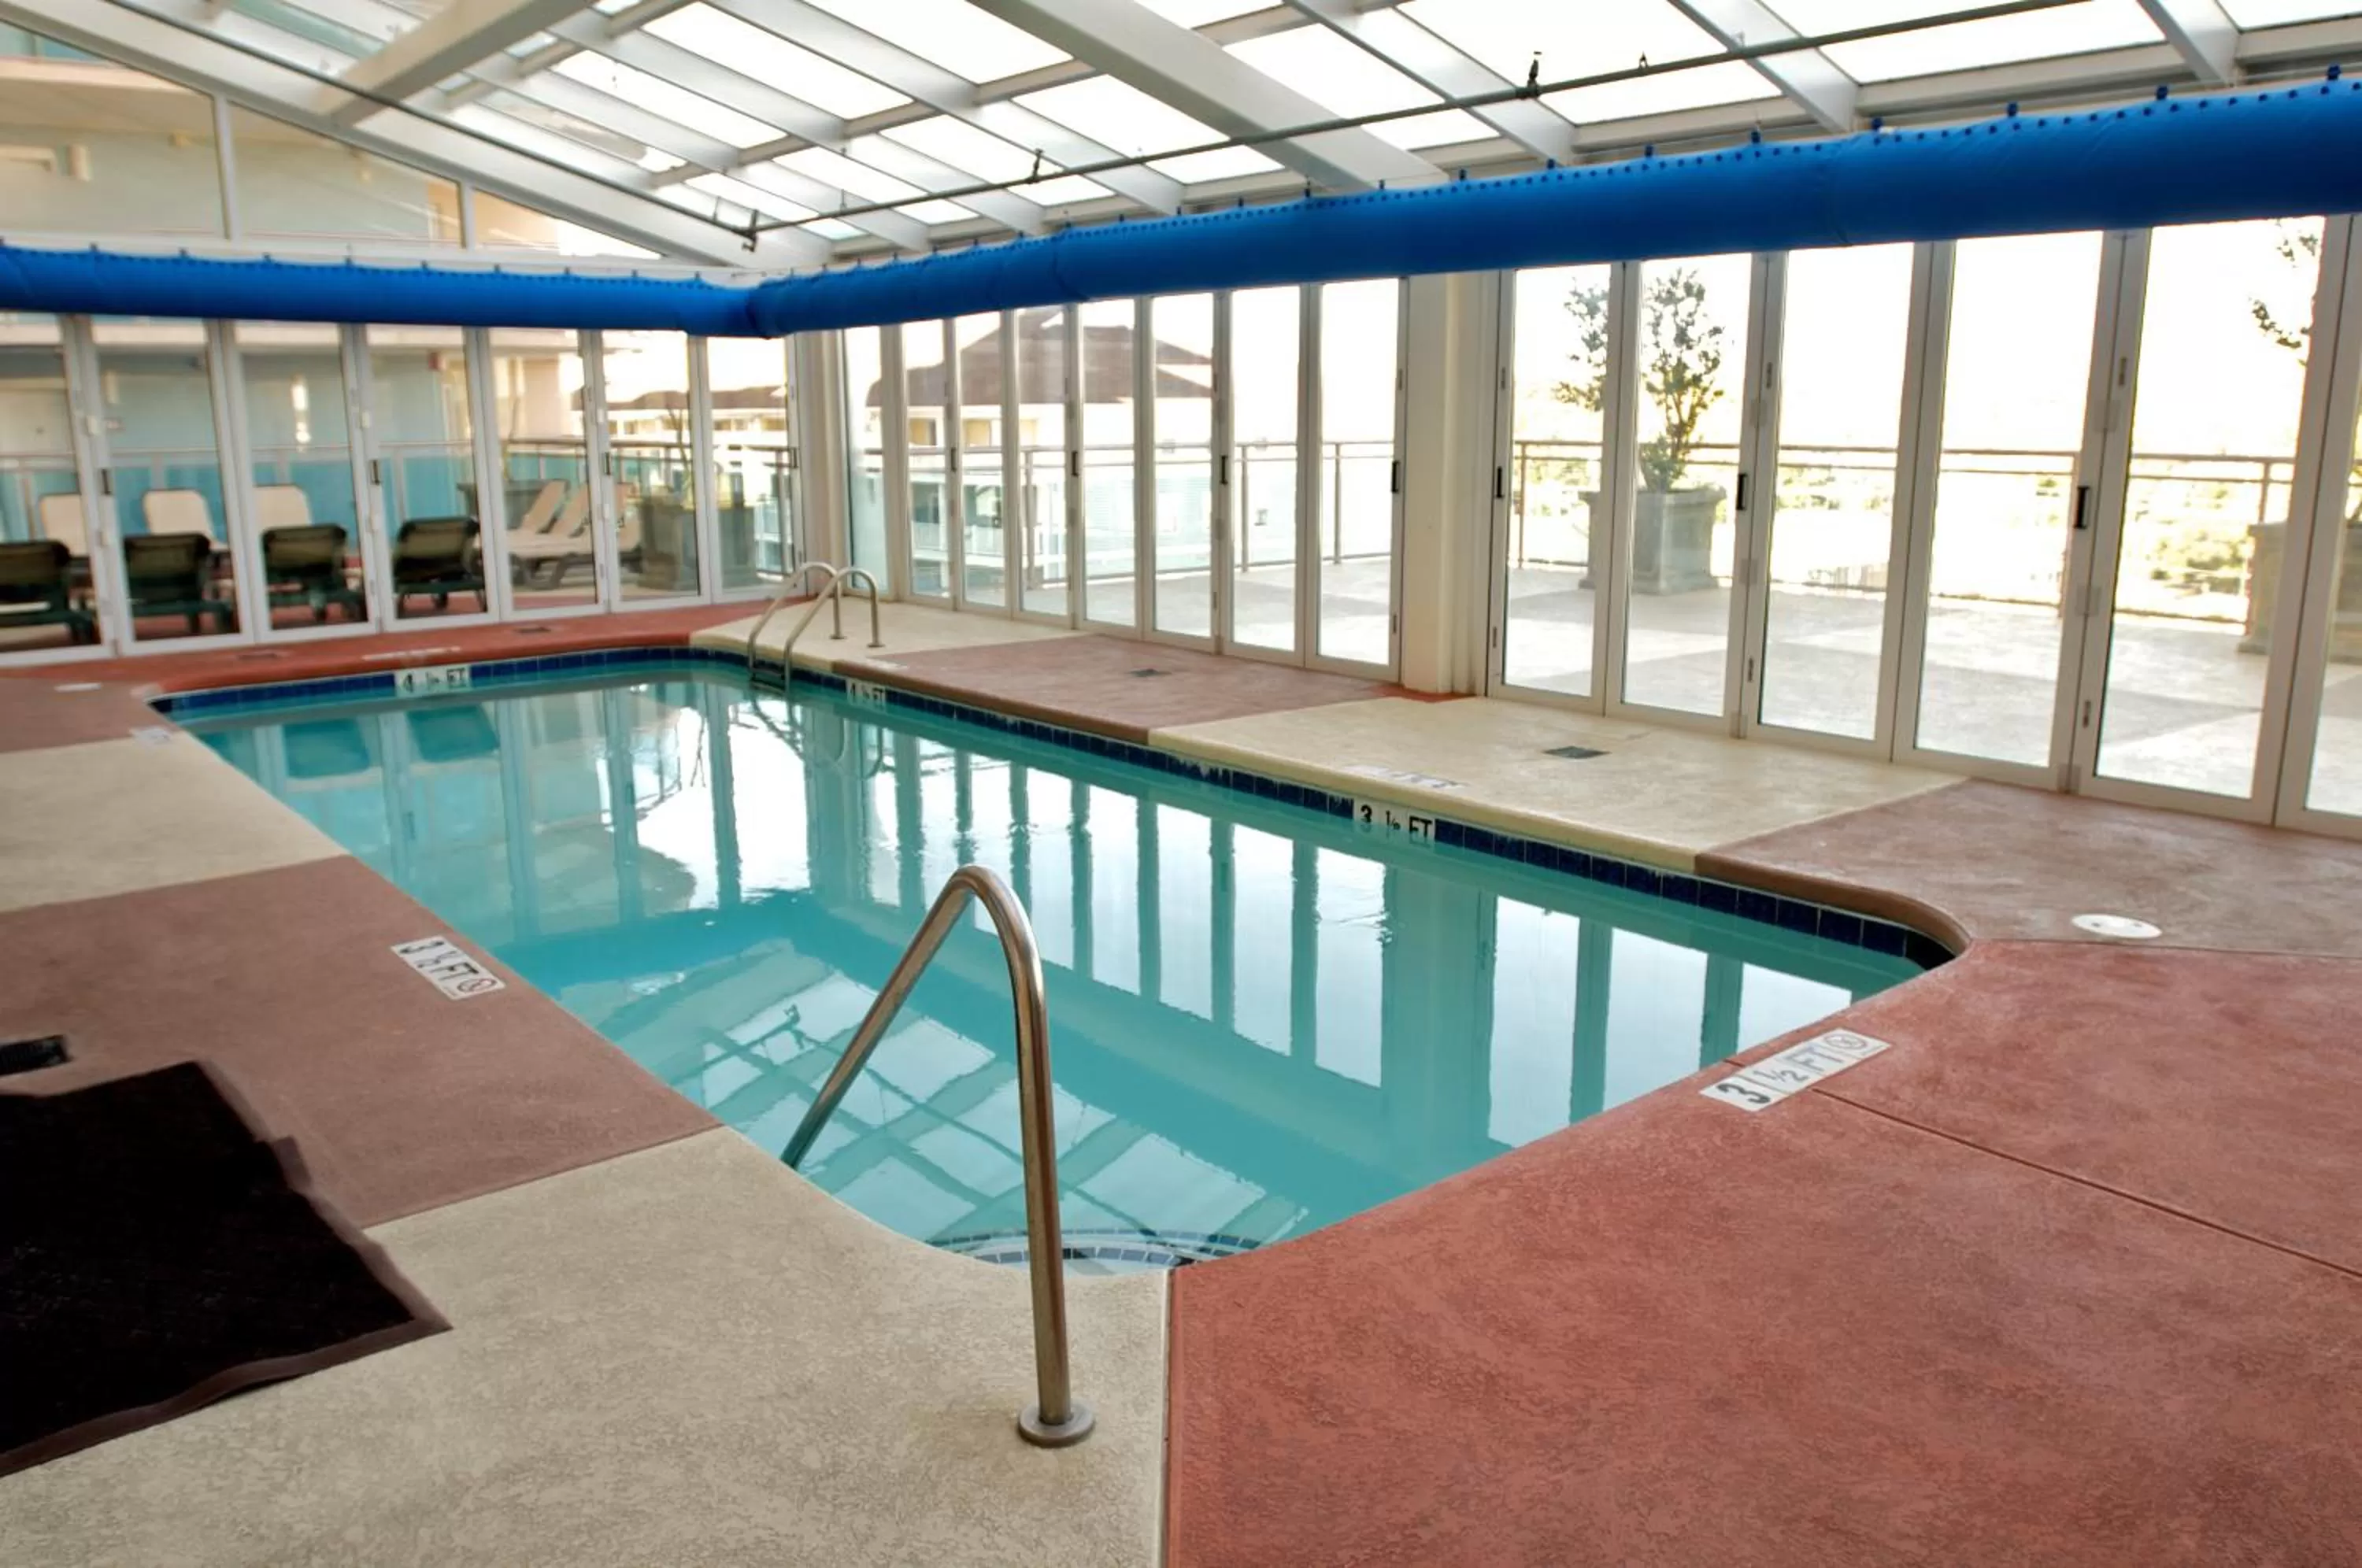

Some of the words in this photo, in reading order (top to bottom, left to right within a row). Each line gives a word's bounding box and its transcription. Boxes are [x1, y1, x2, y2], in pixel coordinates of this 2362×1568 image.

[1409, 815, 1432, 843] FT
[429, 961, 479, 981] FT
[1716, 1082, 1771, 1104] 3
[1784, 1044, 1845, 1073] FT
